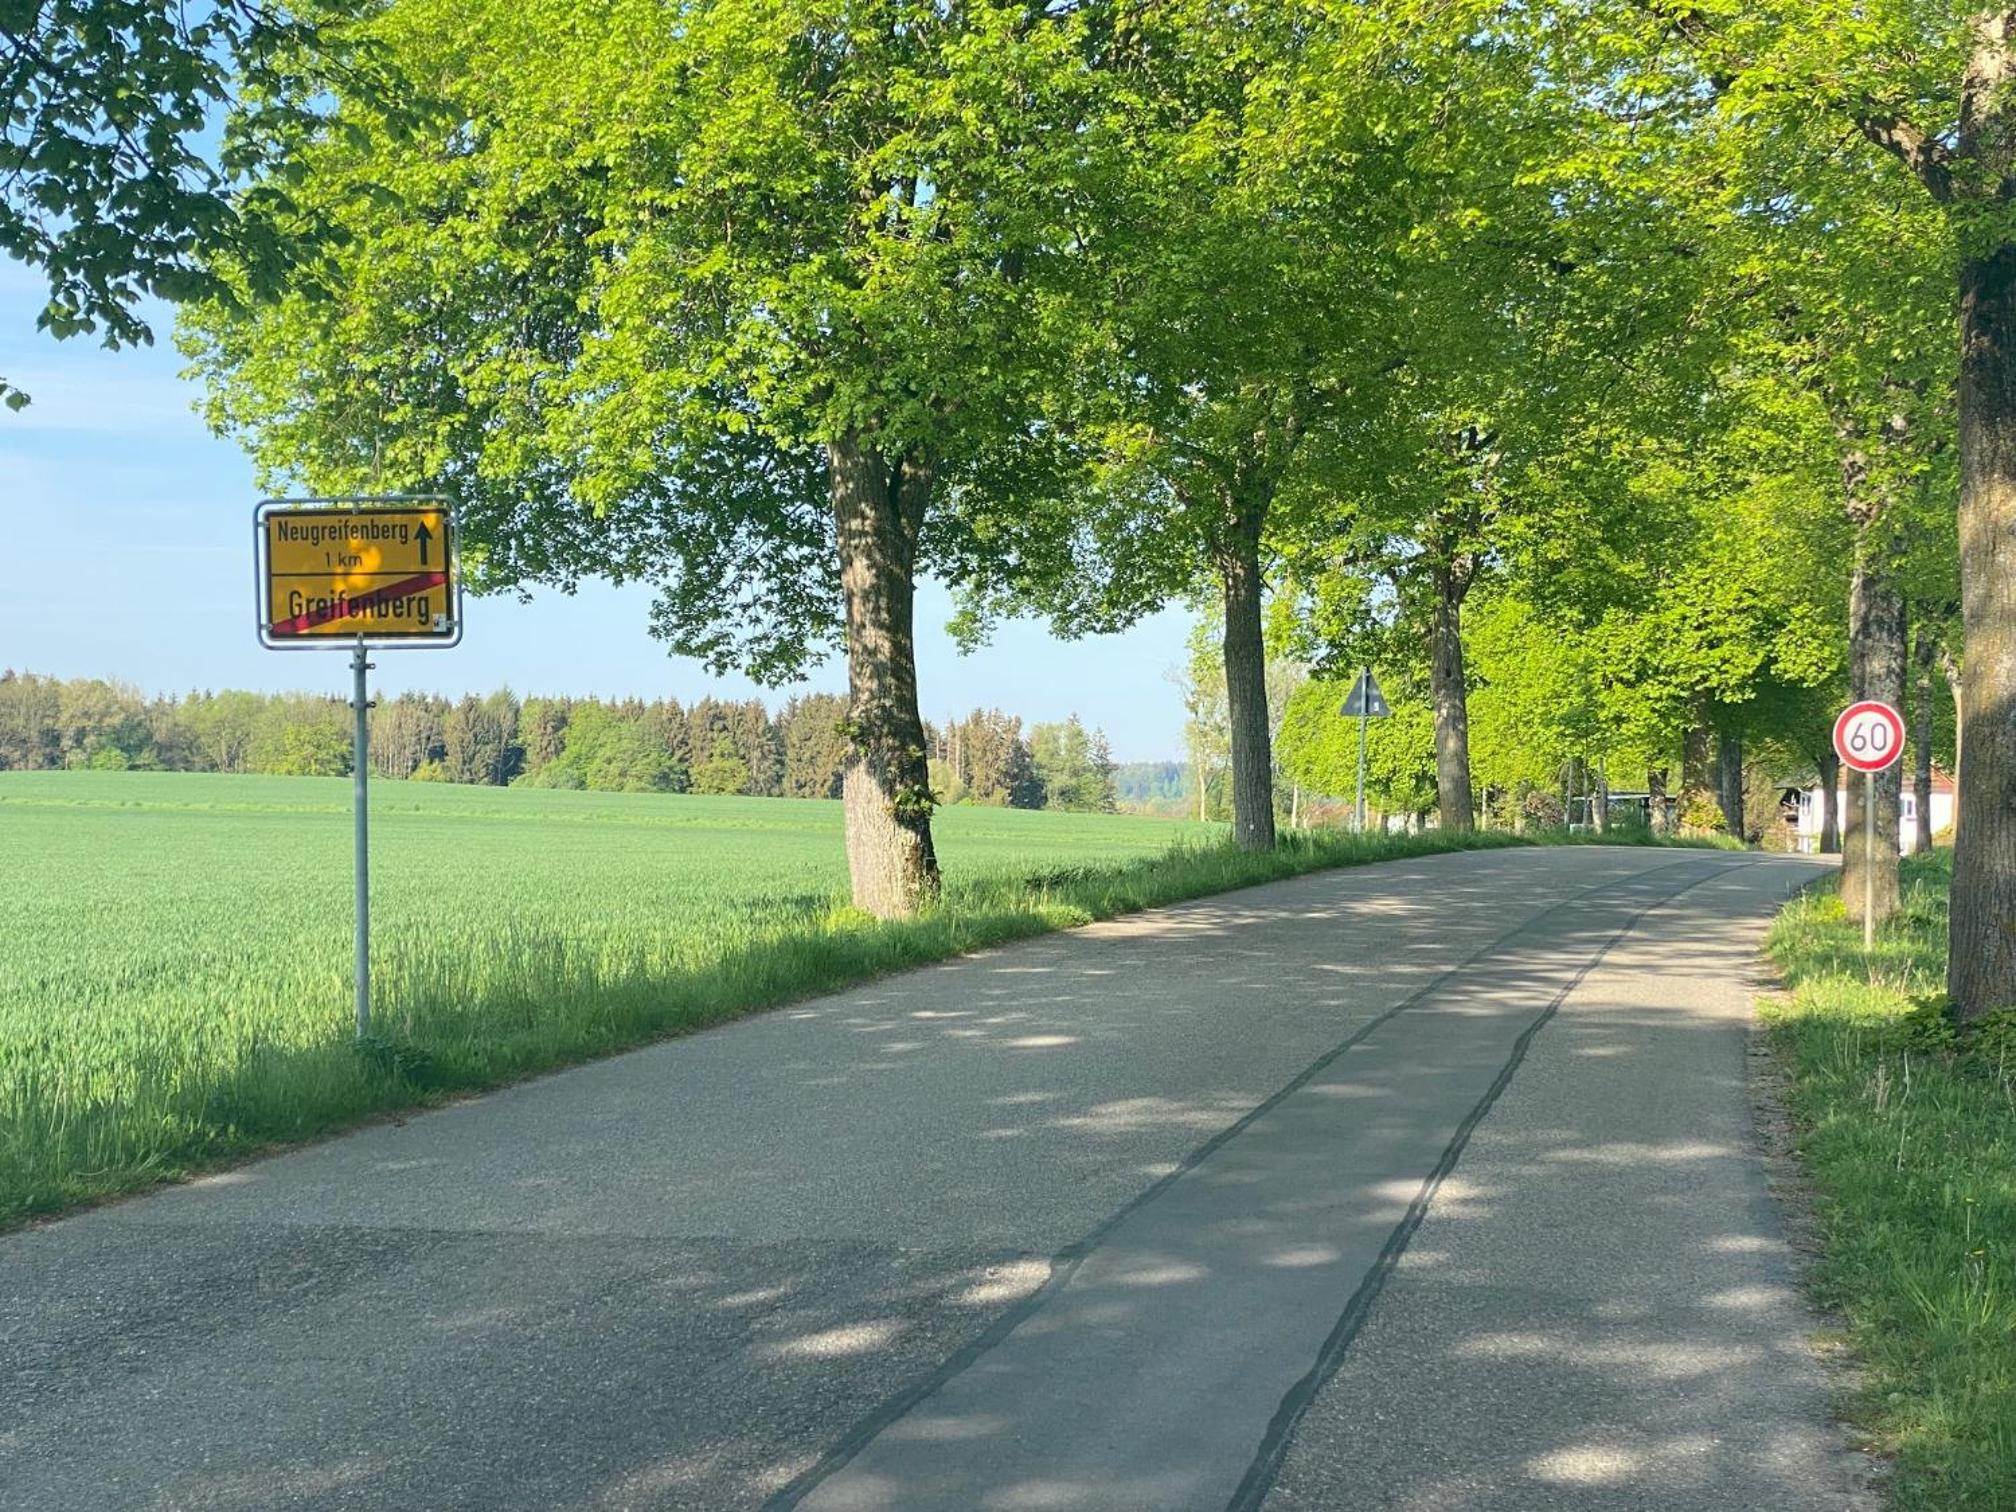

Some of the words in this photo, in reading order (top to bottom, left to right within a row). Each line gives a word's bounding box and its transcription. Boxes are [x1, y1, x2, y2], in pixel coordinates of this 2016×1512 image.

[278, 519, 408, 545] Neugreifenberg
[325, 552, 331, 567] 1
[338, 552, 363, 567] km
[289, 590, 429, 625] Greifenberg
[1851, 722, 1886, 751] 60
